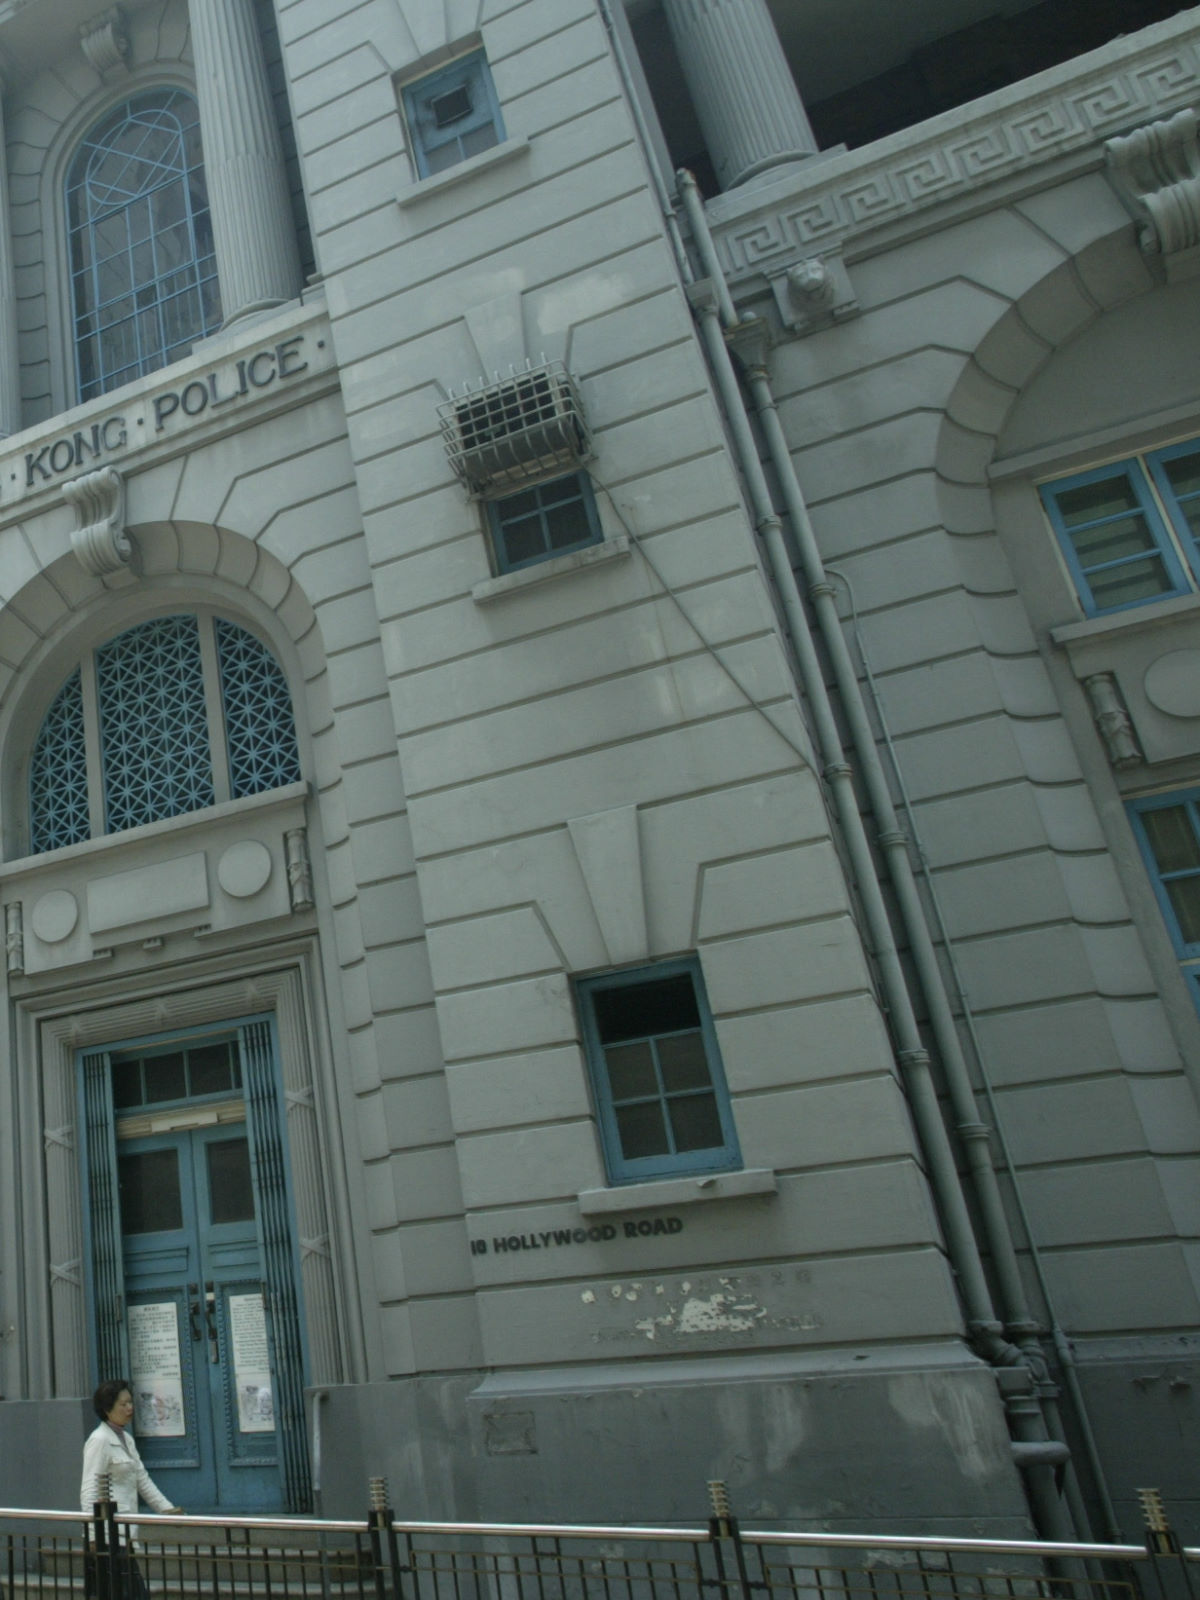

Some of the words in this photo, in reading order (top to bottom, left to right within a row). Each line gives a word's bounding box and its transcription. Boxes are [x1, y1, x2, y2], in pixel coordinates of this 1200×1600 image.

[25, 417, 128, 487] KONG
[152, 336, 308, 432] POLICE
[492, 1225, 616, 1254] HOLLYWOOD
[623, 1217, 683, 1239] ROAD
